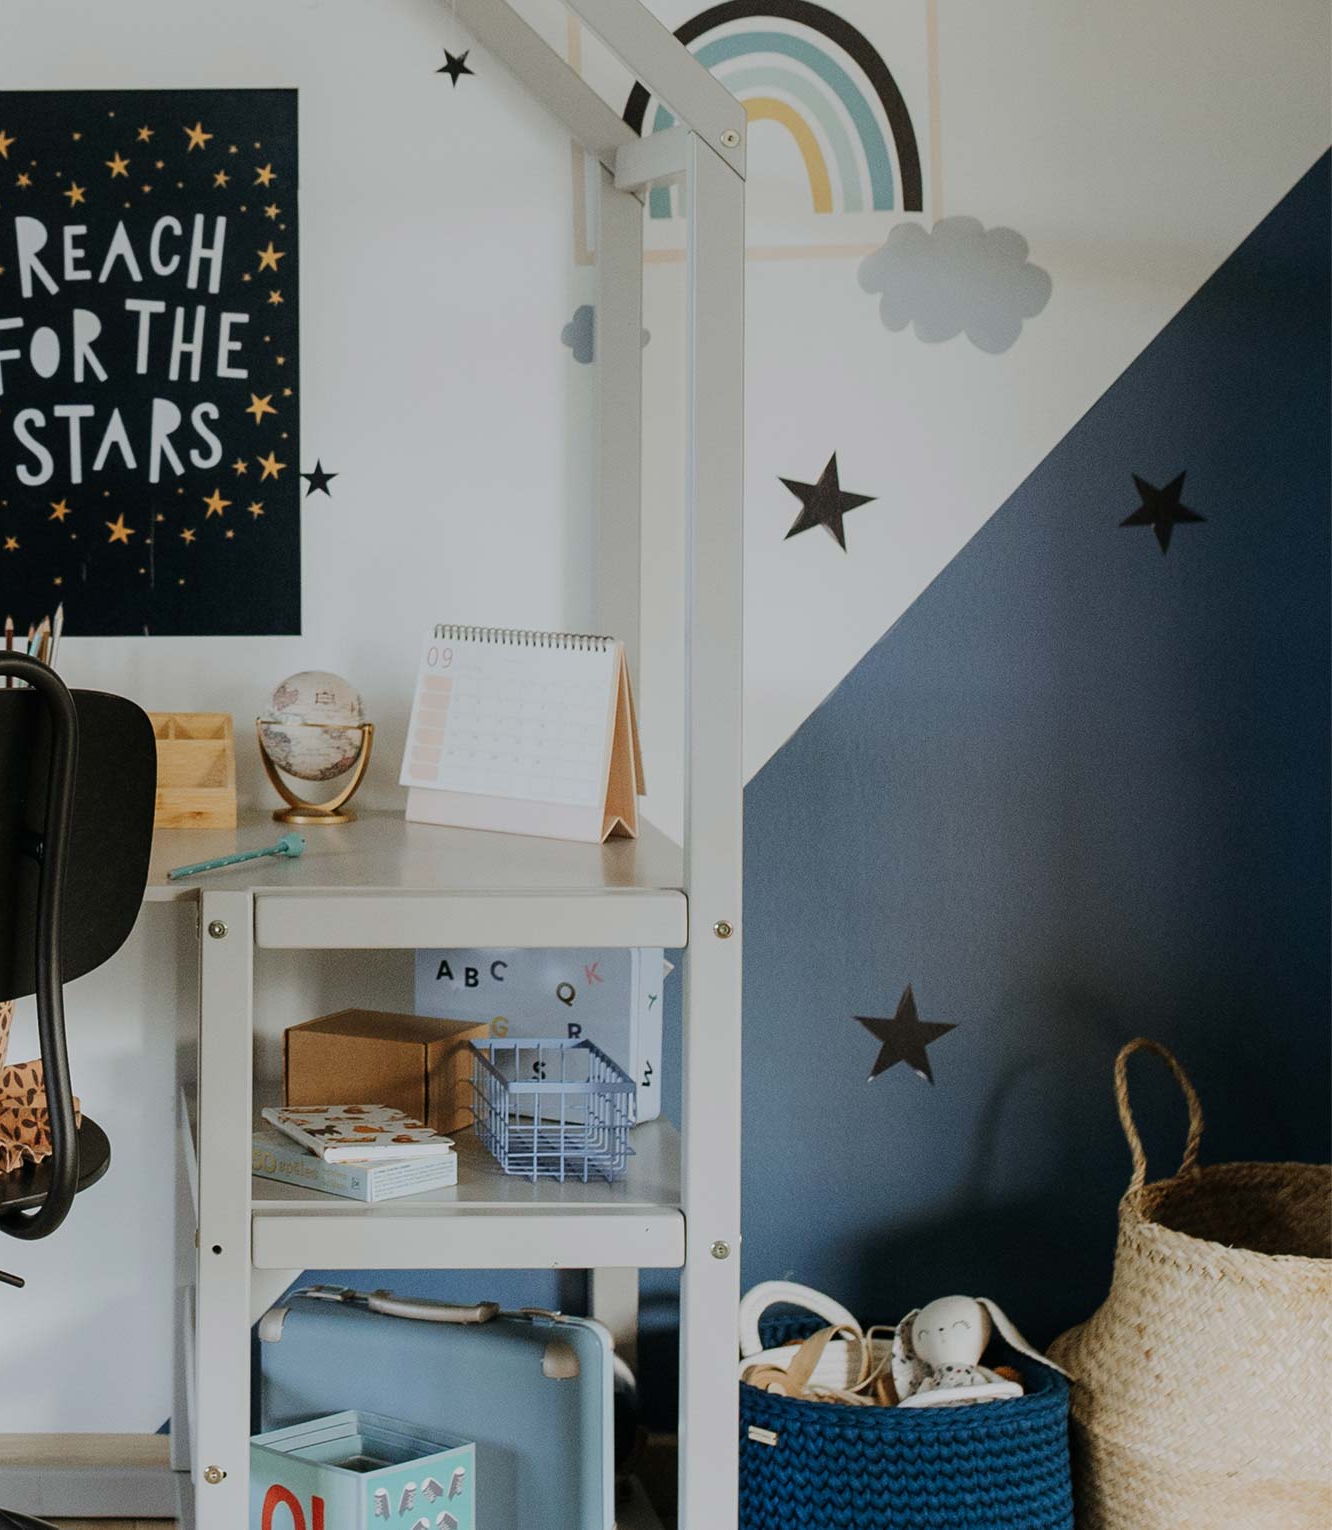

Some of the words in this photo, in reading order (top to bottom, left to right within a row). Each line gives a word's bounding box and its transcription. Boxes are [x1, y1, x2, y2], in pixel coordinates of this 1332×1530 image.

[15, 214, 226, 298] REACH
[125, 299, 249, 382] THE
[14, 398, 222, 486] STARS
[427, 646, 453, 668] 09
[584, 962, 603, 984] K
[556, 982, 576, 1007] Q
[491, 1016, 508, 1038] G
[567, 1023, 582, 1039] R
